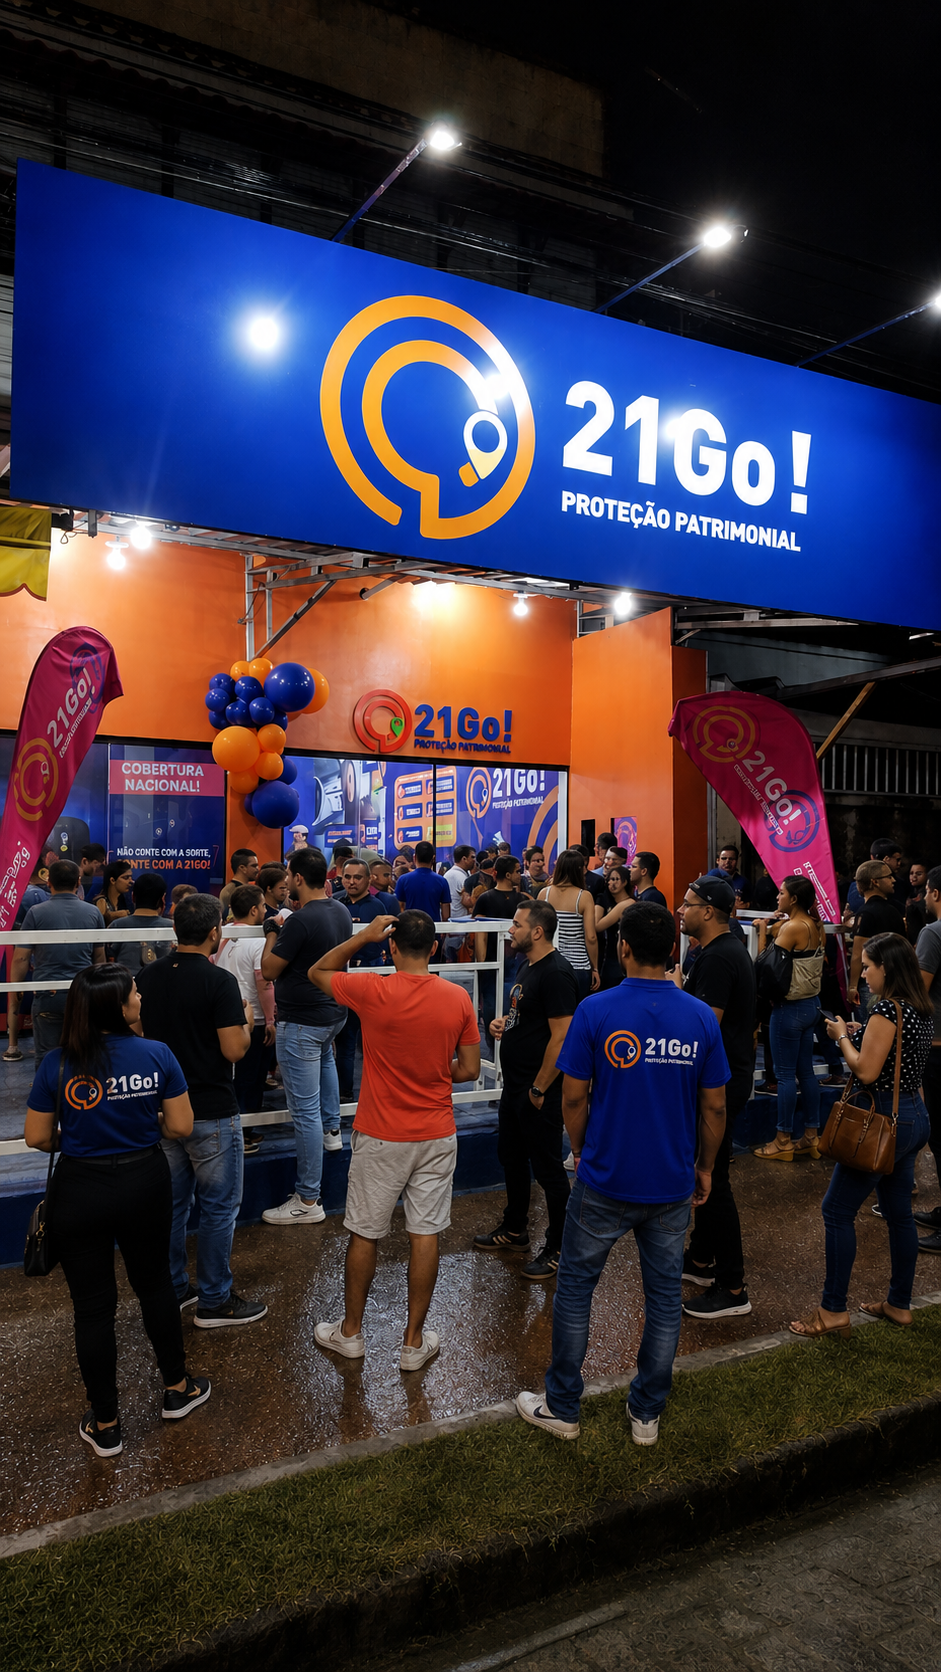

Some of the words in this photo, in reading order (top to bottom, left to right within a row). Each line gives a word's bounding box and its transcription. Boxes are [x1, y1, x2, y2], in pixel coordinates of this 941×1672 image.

[562, 380, 812, 515] 21Go!
[561, 490, 671, 529] PROTEÇÃO
[675, 511, 801, 552] PATRIMONIAL
[414, 703, 513, 743] 21Go!
[414, 738, 457, 754] PROTEÇÃO
[121, 762, 204, 777] COBERTURA
[125, 779, 200, 792] NACIONAL!
[117, 846, 133, 857] NÃO
[135, 848, 160, 857] CONTE
[161, 848, 177, 857] COM
[179, 849, 185, 857] A
[152, 859, 174, 870] COM
[176, 860, 183, 870] A
[644, 1037, 699, 1059] 21Go!
[106, 1071, 159, 1094] 21Go!
